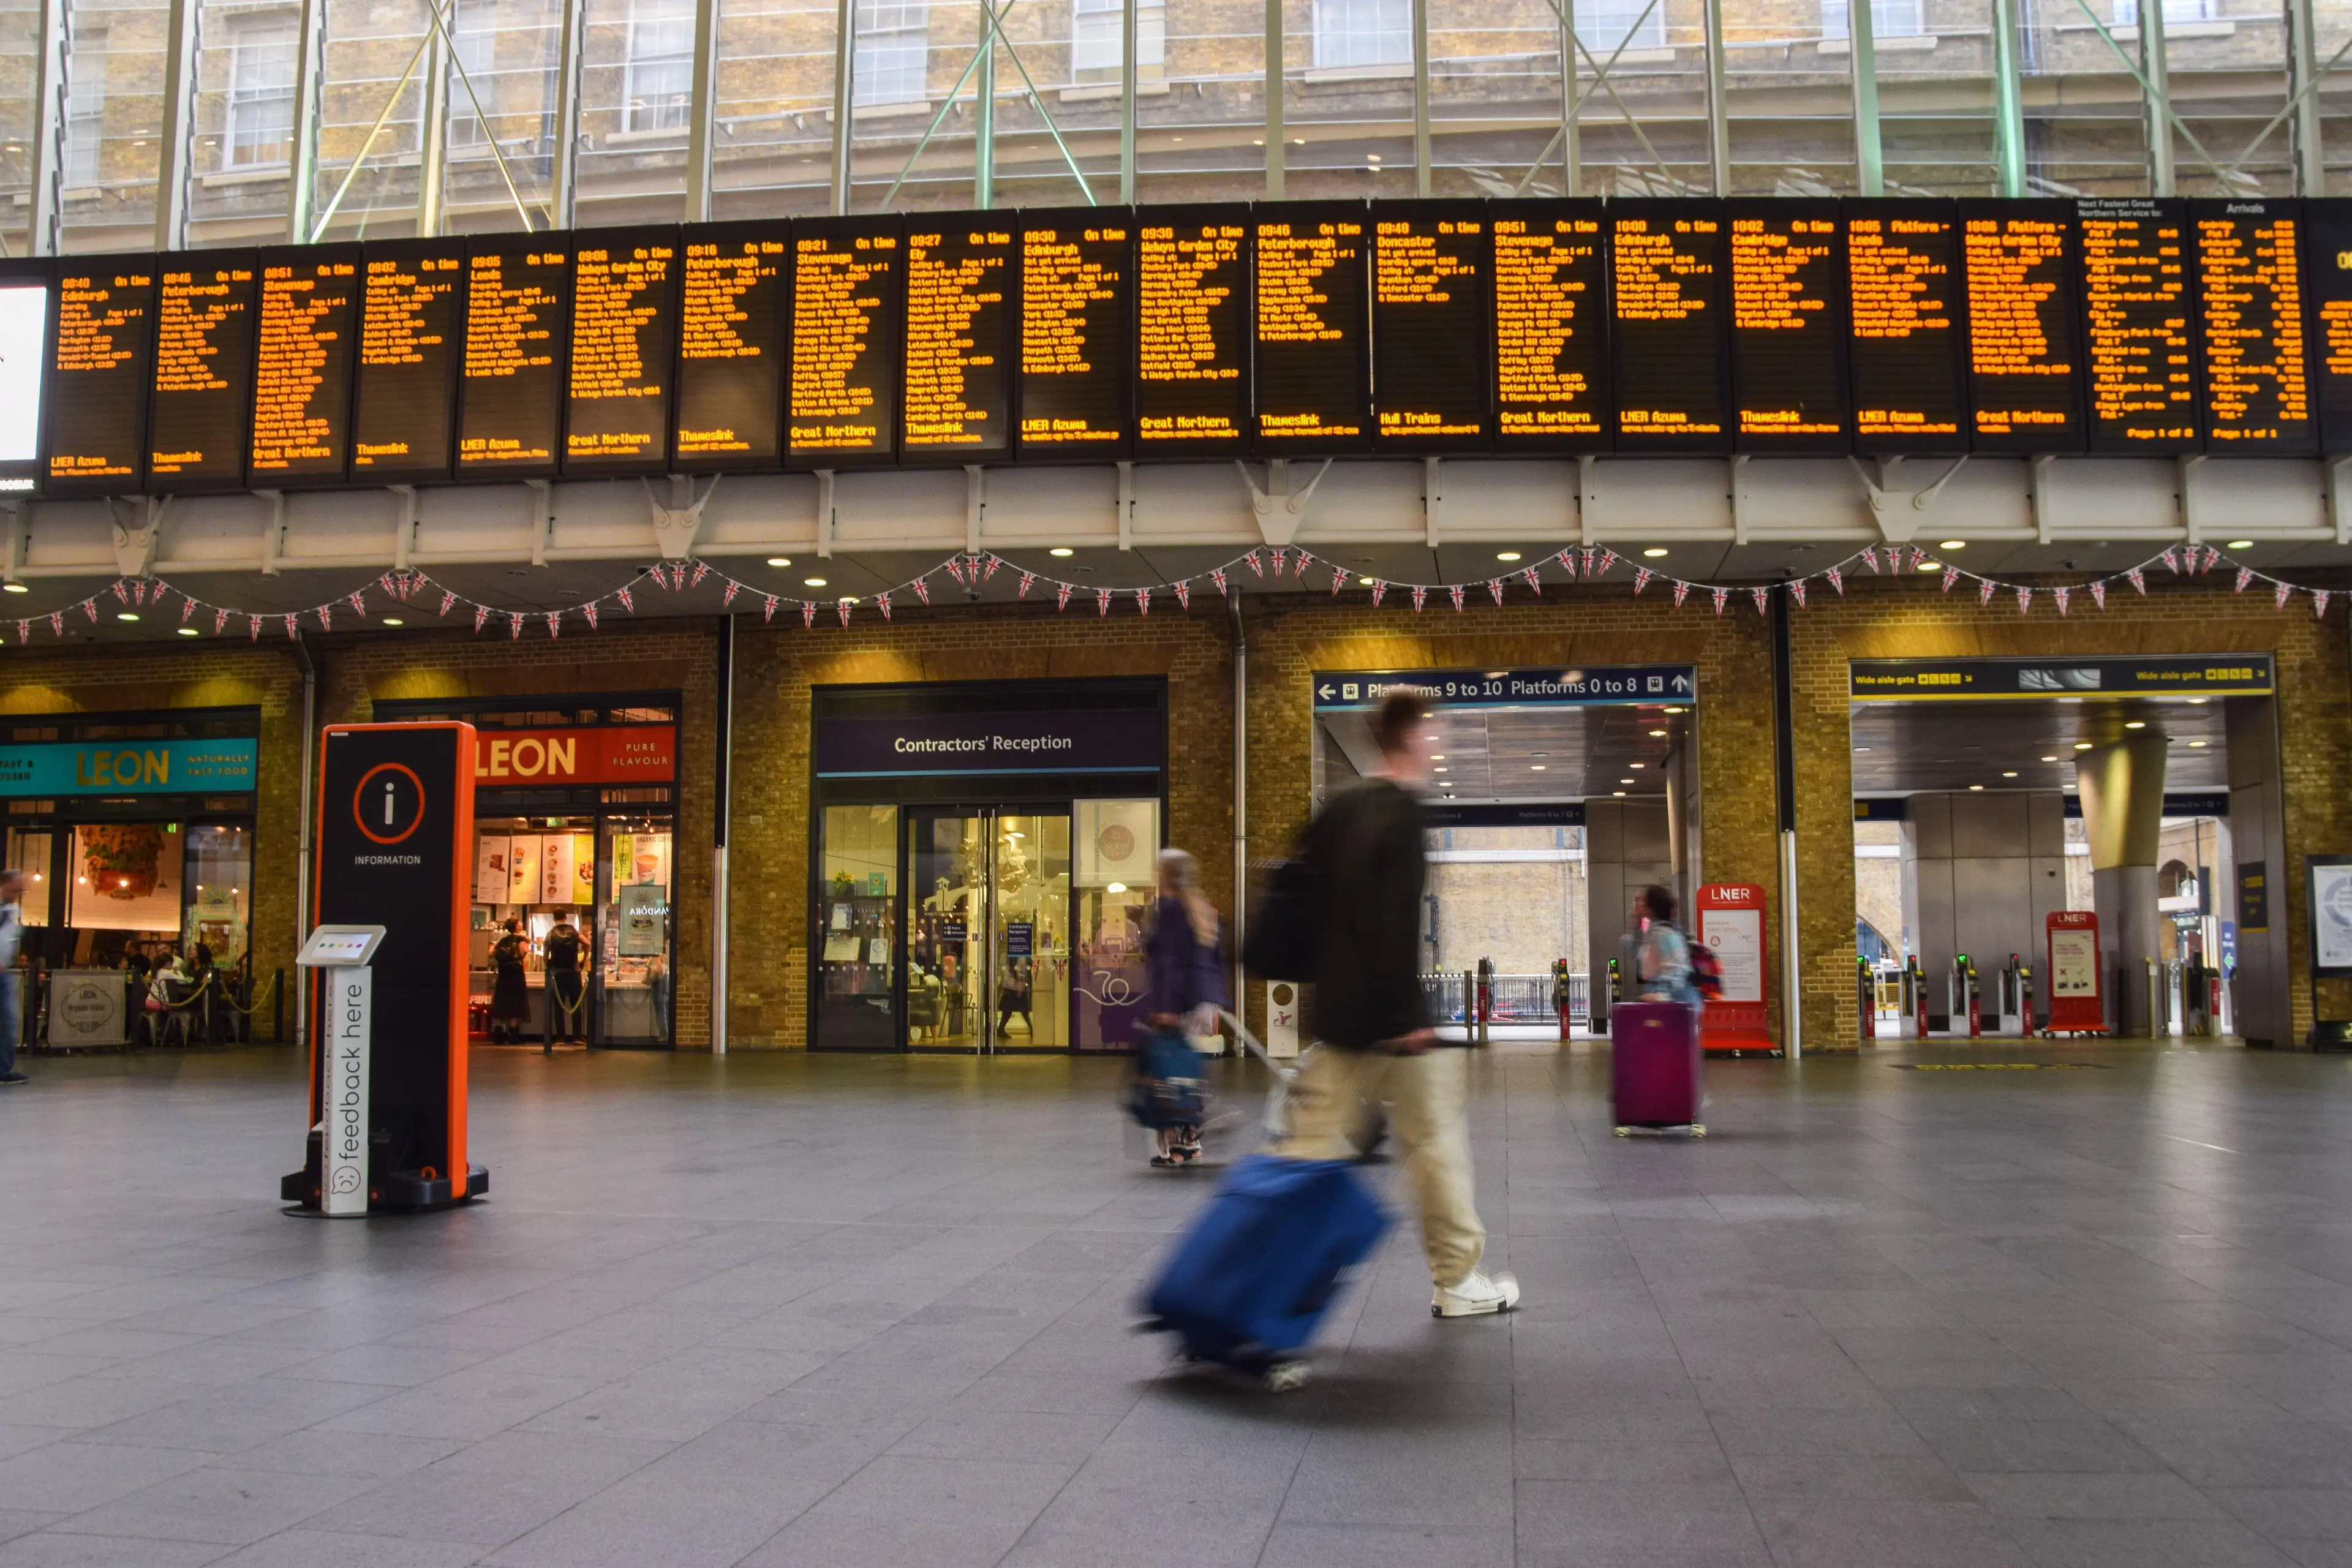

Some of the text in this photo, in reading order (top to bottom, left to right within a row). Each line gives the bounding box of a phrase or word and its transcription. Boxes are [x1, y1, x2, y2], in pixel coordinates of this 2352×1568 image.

[2226, 203, 2264, 213] Arrivals
[1141, 226, 1243, 240] 09:36 On time
[1258, 224, 1361, 237] 09:46 On time
[1438, 222, 1453, 233] On
[1457, 222, 1480, 233] time
[1494, 221, 1597, 234] 09:51 On time
[1616, 221, 1717, 232] 10:00 On time
[1733, 221, 1834, 234] 10:02 On time
[910, 232, 1010, 247] 09:27 On time
[1024, 228, 1126, 245] 09:30 On time
[1258, 237, 1335, 249] Peterborough
[1378, 236, 1435, 248] Doncaster
[1495, 235, 1553, 247] Stevenage
[1615, 234, 1670, 246] Edinburgh
[687, 242, 783, 257] 09:16 On time
[797, 238, 895, 252] 09:21 On time
[1024, 243, 1079, 257] Edinburgh
[1141, 239, 1237, 254] Welwyn Garden City
[634, 249, 649, 259] On
[651, 247, 673, 258] time
[797, 254, 853, 265] Stevenage
[910, 248, 926, 260] Ely
[368, 260, 459, 274] 09:02 On time
[472, 254, 564, 268] 09:05 On time
[578, 260, 666, 275] Welwyn Garden City
[686, 256, 758, 268] Peterborough
[216, 271, 229, 282] On
[232, 271, 252, 281] time
[368, 274, 417, 285] Cambridge
[471, 270, 501, 281] Leeds
[163, 284, 229, 298] Peterborough
[264, 281, 315, 292] Stevenage
[62, 291, 108, 301] Edinburgh
[1261, 413, 1319, 427] Thameslink
[1380, 412, 1441, 425] Hull Trains
[1501, 412, 1591, 424] Great Northern
[1621, 411, 1687, 423] LNER Azuma
[1741, 410, 1800, 423] Thameslink
[907, 421, 963, 436] Thameslink
[1022, 419, 1087, 432] LNER Azuma
[1140, 417, 1229, 431] Great Northern
[680, 429, 734, 443] Thameslink
[791, 425, 876, 440] Great Northern
[461, 438, 520, 451] LNER Azuma
[568, 433, 651, 448] Great Northern
[253, 446, 331, 462] Great Northern
[357, 443, 408, 458] Thameslink
[153, 452, 202, 463] Thameslink
[1856, 674, 1915, 685] Wide aisle gate
[2136, 671, 2201, 682] Wide aisle gate
[1368, 679, 1502, 698] Plarms 9 to 10
[1511, 677, 1637, 696] Platforms 0 to 8
[626, 743, 656, 752] PURE
[894, 735, 1071, 753] Contractors' Reception
[188, 754, 250, 763] NATURALLY
[475, 738, 575, 777] LEON
[613, 756, 668, 766] FLAVOUR
[77, 750, 168, 785] LEON
[1711, 888, 1750, 900] LNER
[2057, 912, 2087, 922] LNER
[339, 984, 362, 1161] feedback here
